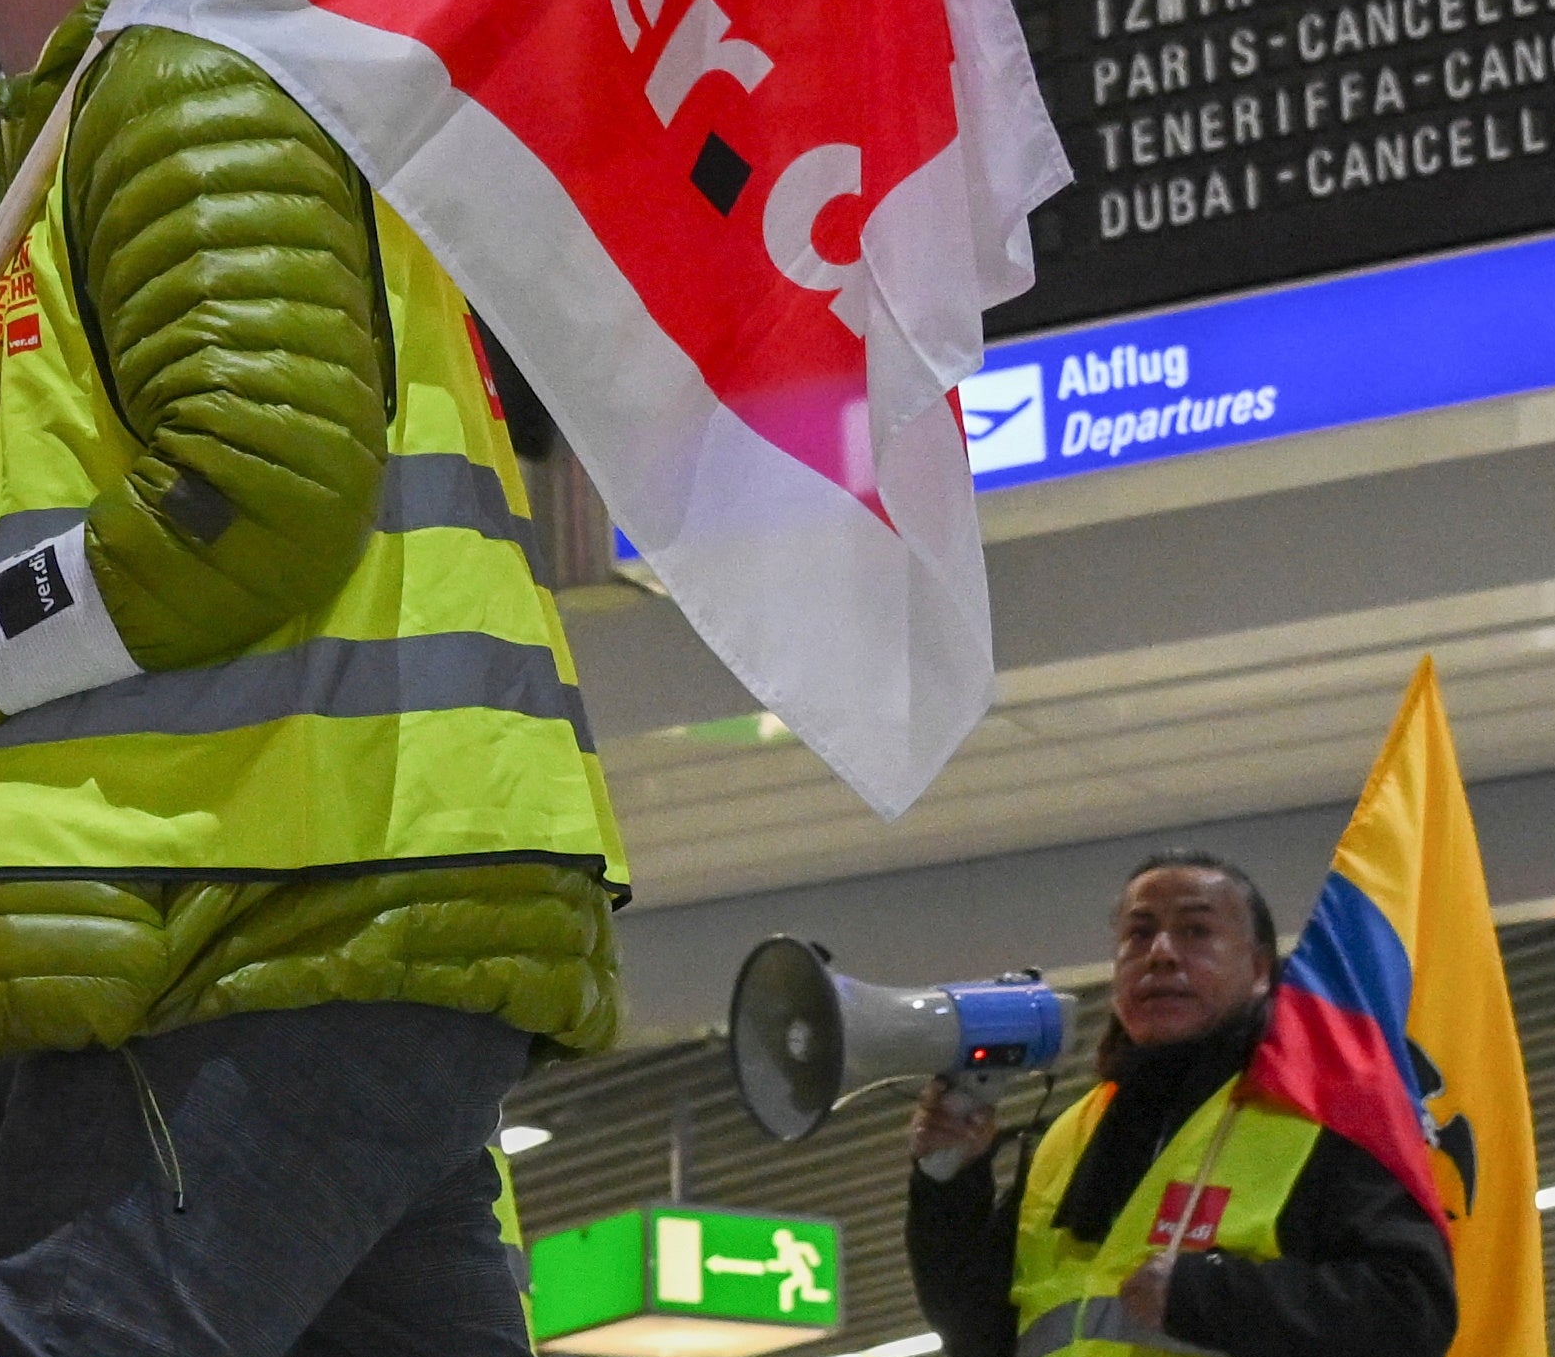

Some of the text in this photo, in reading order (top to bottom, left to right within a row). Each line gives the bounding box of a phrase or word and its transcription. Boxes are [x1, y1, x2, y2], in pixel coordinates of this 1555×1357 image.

[8, 335, 39, 349] ver.di
[1058, 338, 1189, 402] Abflug
[1060, 383, 1277, 458] Departures
